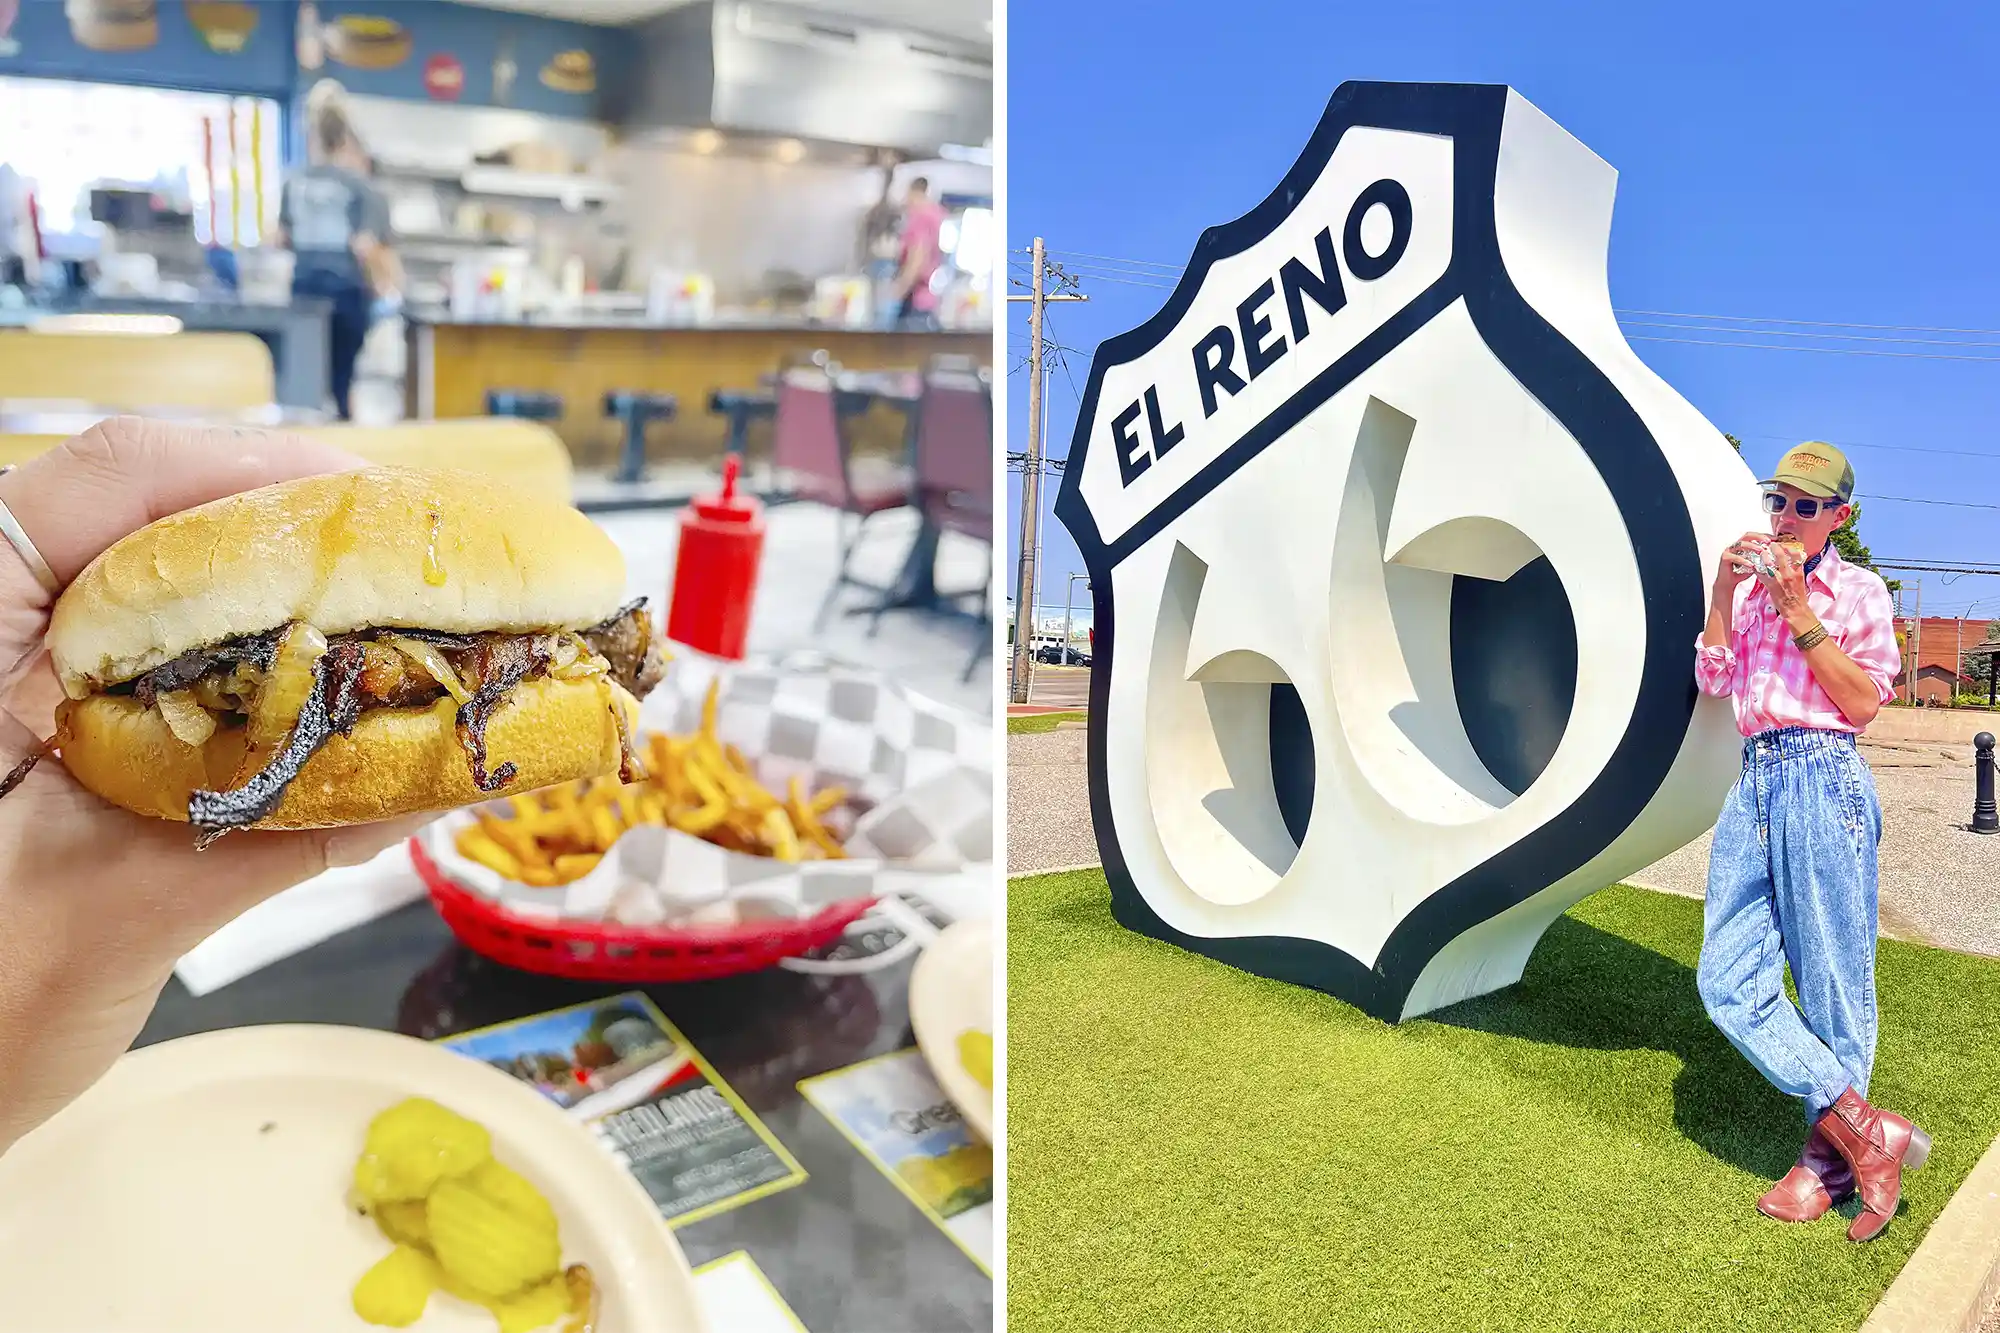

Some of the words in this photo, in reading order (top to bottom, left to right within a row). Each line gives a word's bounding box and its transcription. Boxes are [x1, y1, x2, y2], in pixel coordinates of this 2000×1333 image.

[1110, 383, 1185, 489] EL
[1191, 178, 1413, 415] RENO
[1145, 394, 1579, 906] 66
